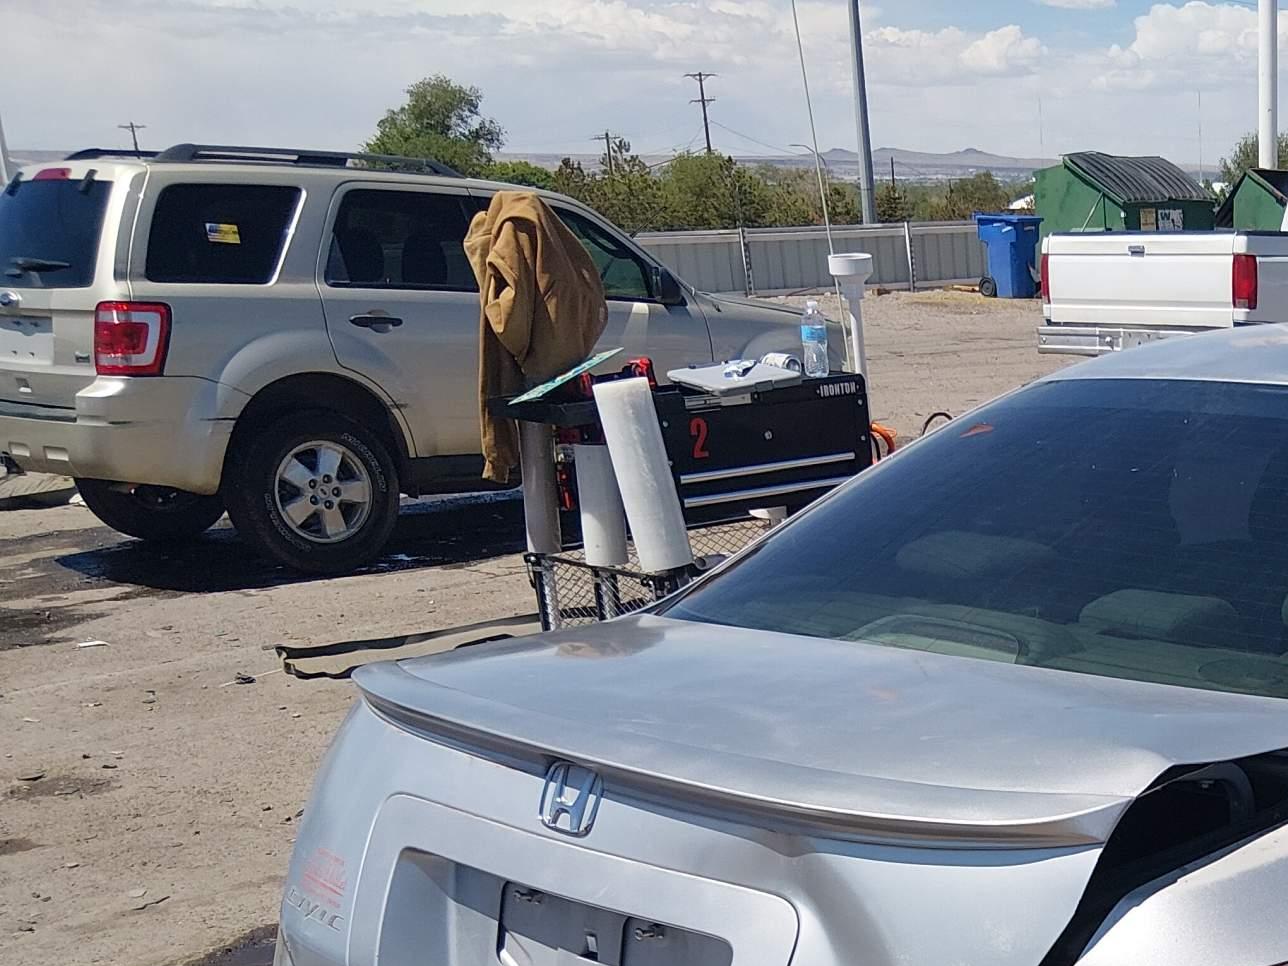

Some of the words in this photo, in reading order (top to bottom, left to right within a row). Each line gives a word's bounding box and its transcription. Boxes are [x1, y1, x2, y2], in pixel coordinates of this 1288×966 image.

[819, 382, 856, 397] IRONTON
[689, 416, 711, 459] 2
[286, 886, 345, 932] CIVIC
